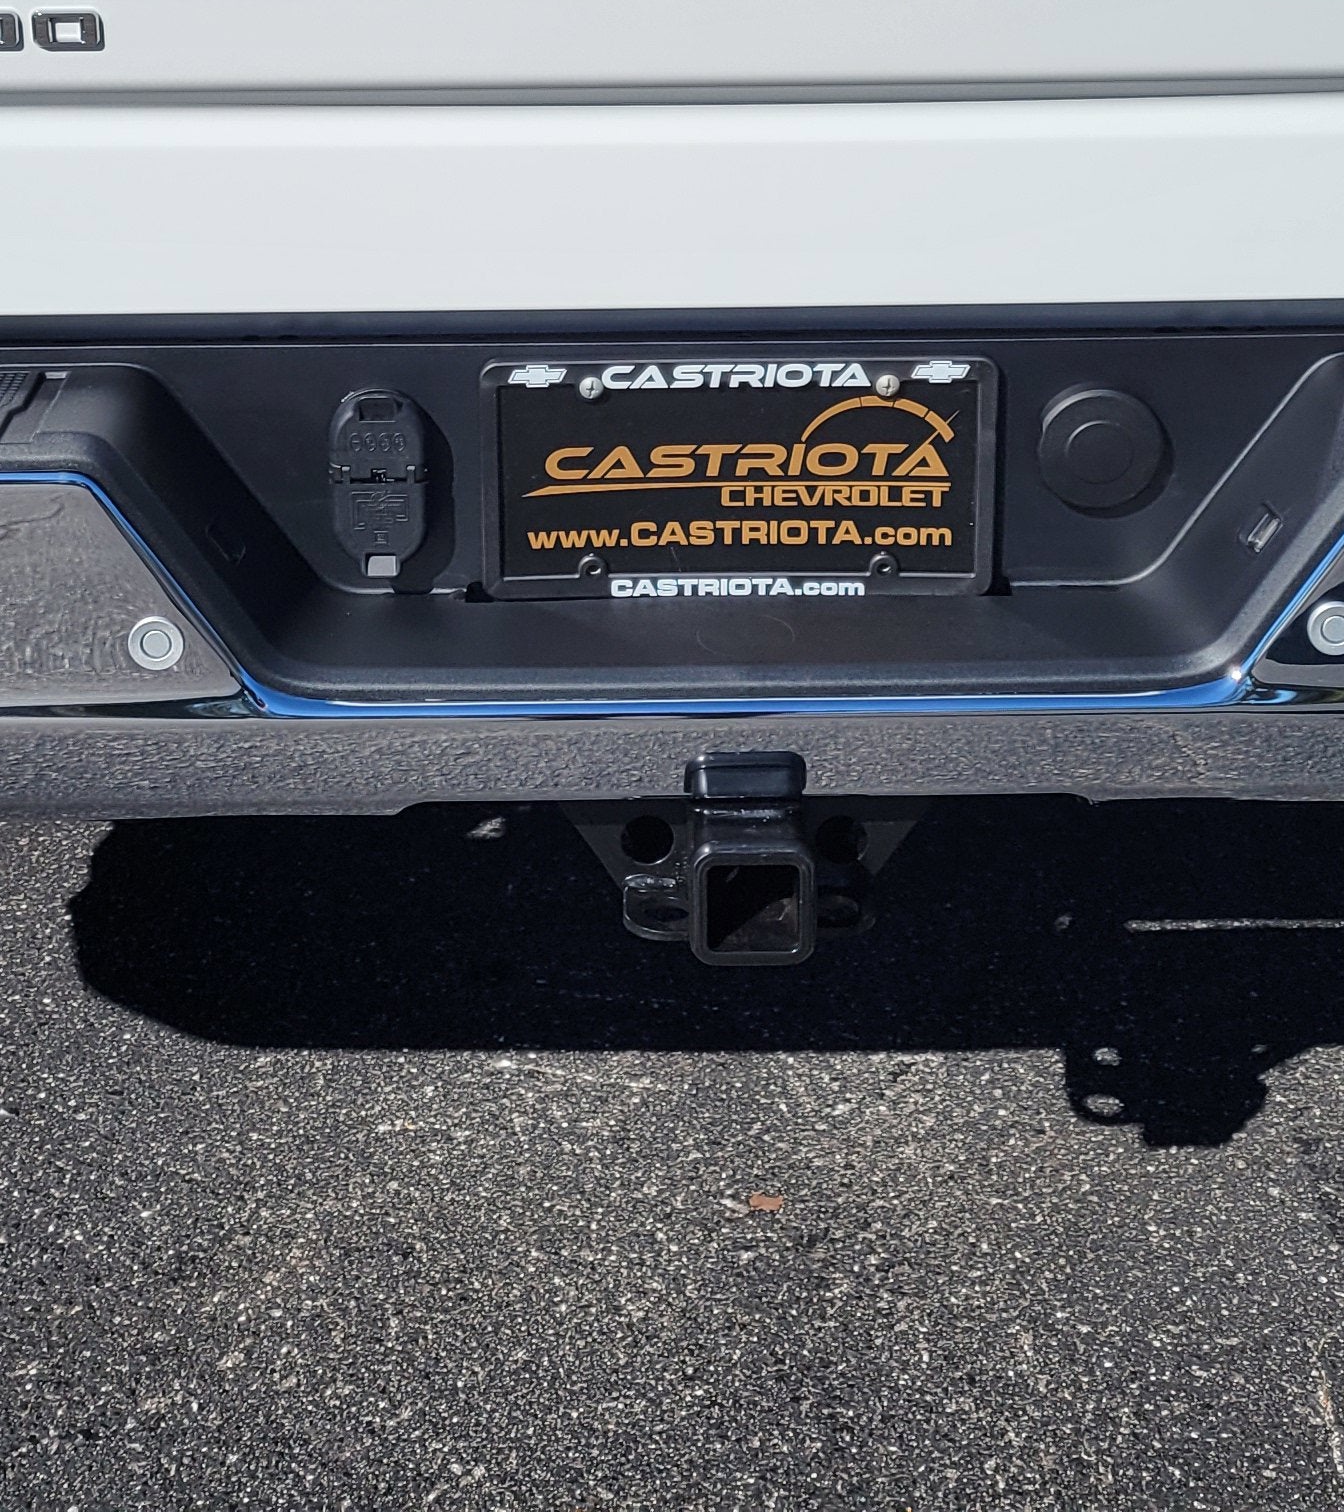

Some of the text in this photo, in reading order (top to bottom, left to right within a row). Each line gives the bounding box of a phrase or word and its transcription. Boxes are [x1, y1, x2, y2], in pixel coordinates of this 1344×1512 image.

[601, 364, 872, 390] CASTRIOTA
[544, 442, 950, 480] CASTRIOTA
[720, 485, 950, 508] CHEVROLET
[527, 520, 953, 549] www.CASTRIOTA.com
[610, 577, 867, 598] CASTRIOTA.com
